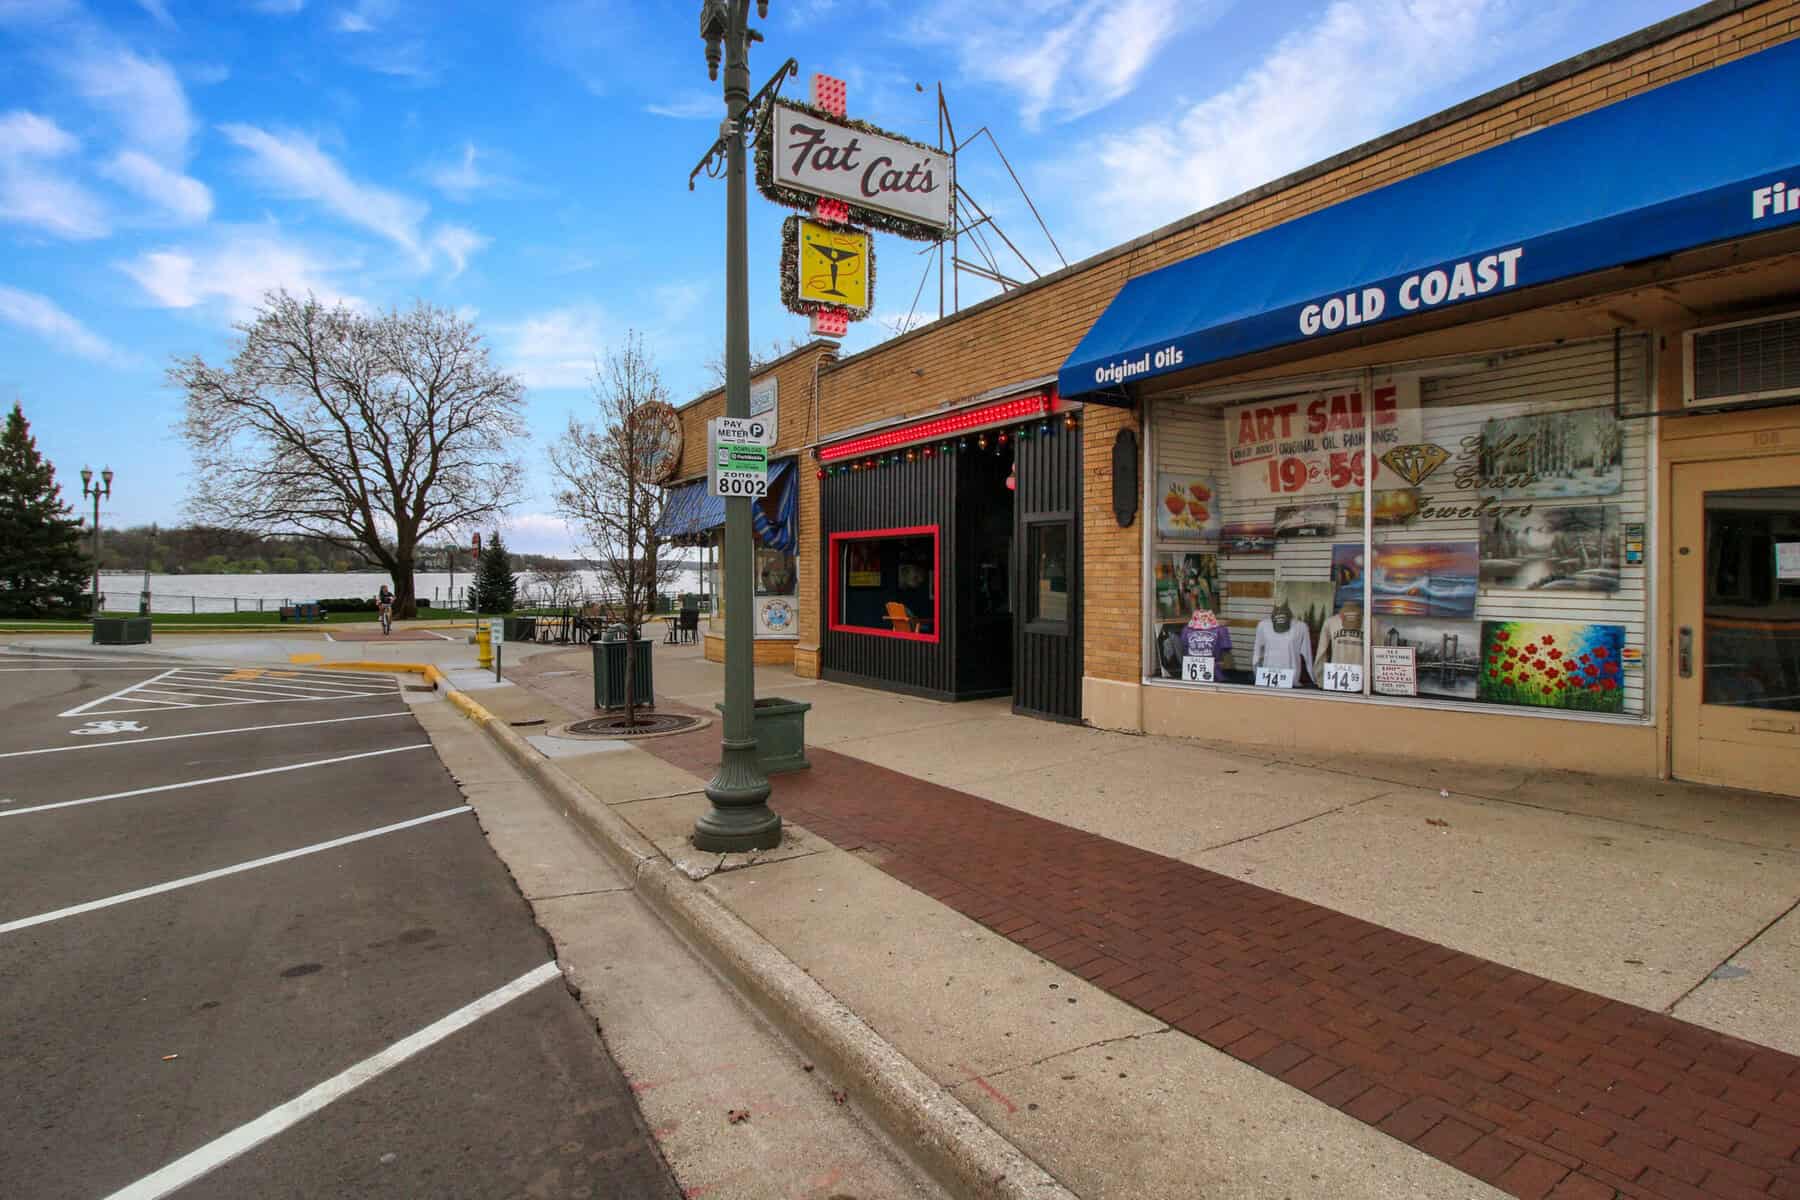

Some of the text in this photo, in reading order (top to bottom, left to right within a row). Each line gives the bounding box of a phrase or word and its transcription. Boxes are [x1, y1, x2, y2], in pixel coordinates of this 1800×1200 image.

[789, 123, 940, 198] Fat Cat's
[1299, 246, 1524, 337] GOLD COAST
[1094, 344, 1184, 384] Original Oils
[723, 420, 742, 428] PAY
[1238, 384, 1398, 445] ART SALE
[718, 429, 749, 438] METER
[1322, 434, 1339, 450] OIL
[1343, 427, 1400, 447] PAININGS
[1456, 432, 1538, 461] Gold
[719, 479, 767, 495] 8002
[1268, 457, 1308, 494] 19
[1453, 464, 1535, 490] Coast
